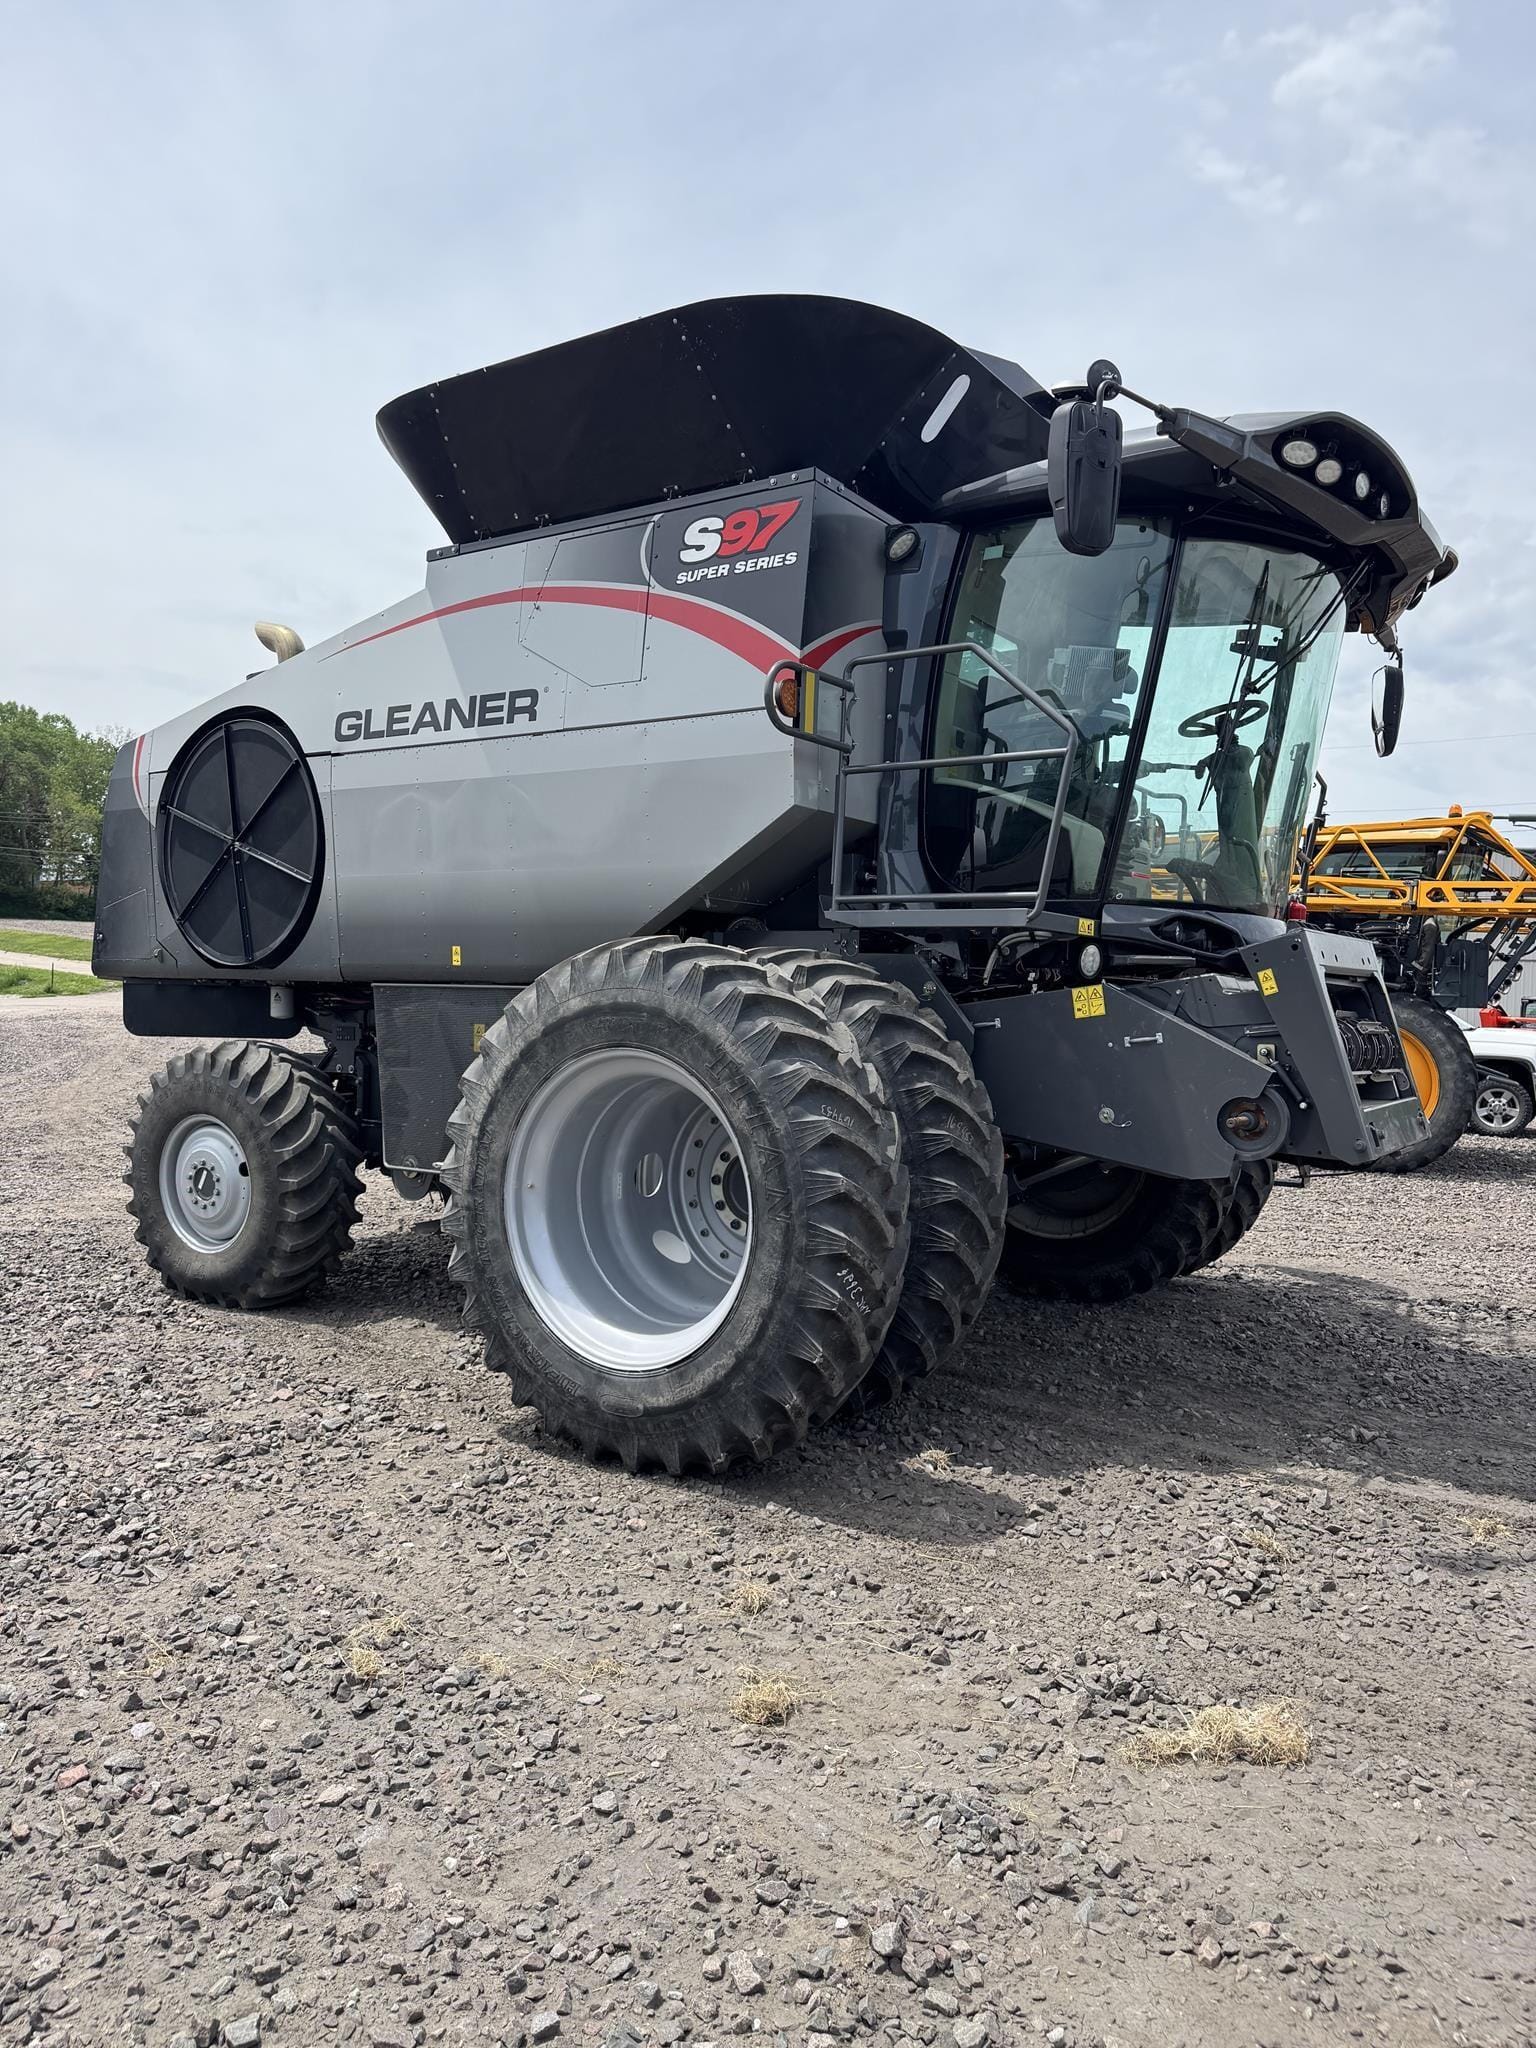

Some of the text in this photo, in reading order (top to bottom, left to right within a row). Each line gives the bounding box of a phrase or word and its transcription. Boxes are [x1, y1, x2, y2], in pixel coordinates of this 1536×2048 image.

[679, 498, 802, 563] S97
[676, 551, 798, 585] SUPER SERIES
[334, 688, 539, 742] GLEANER
